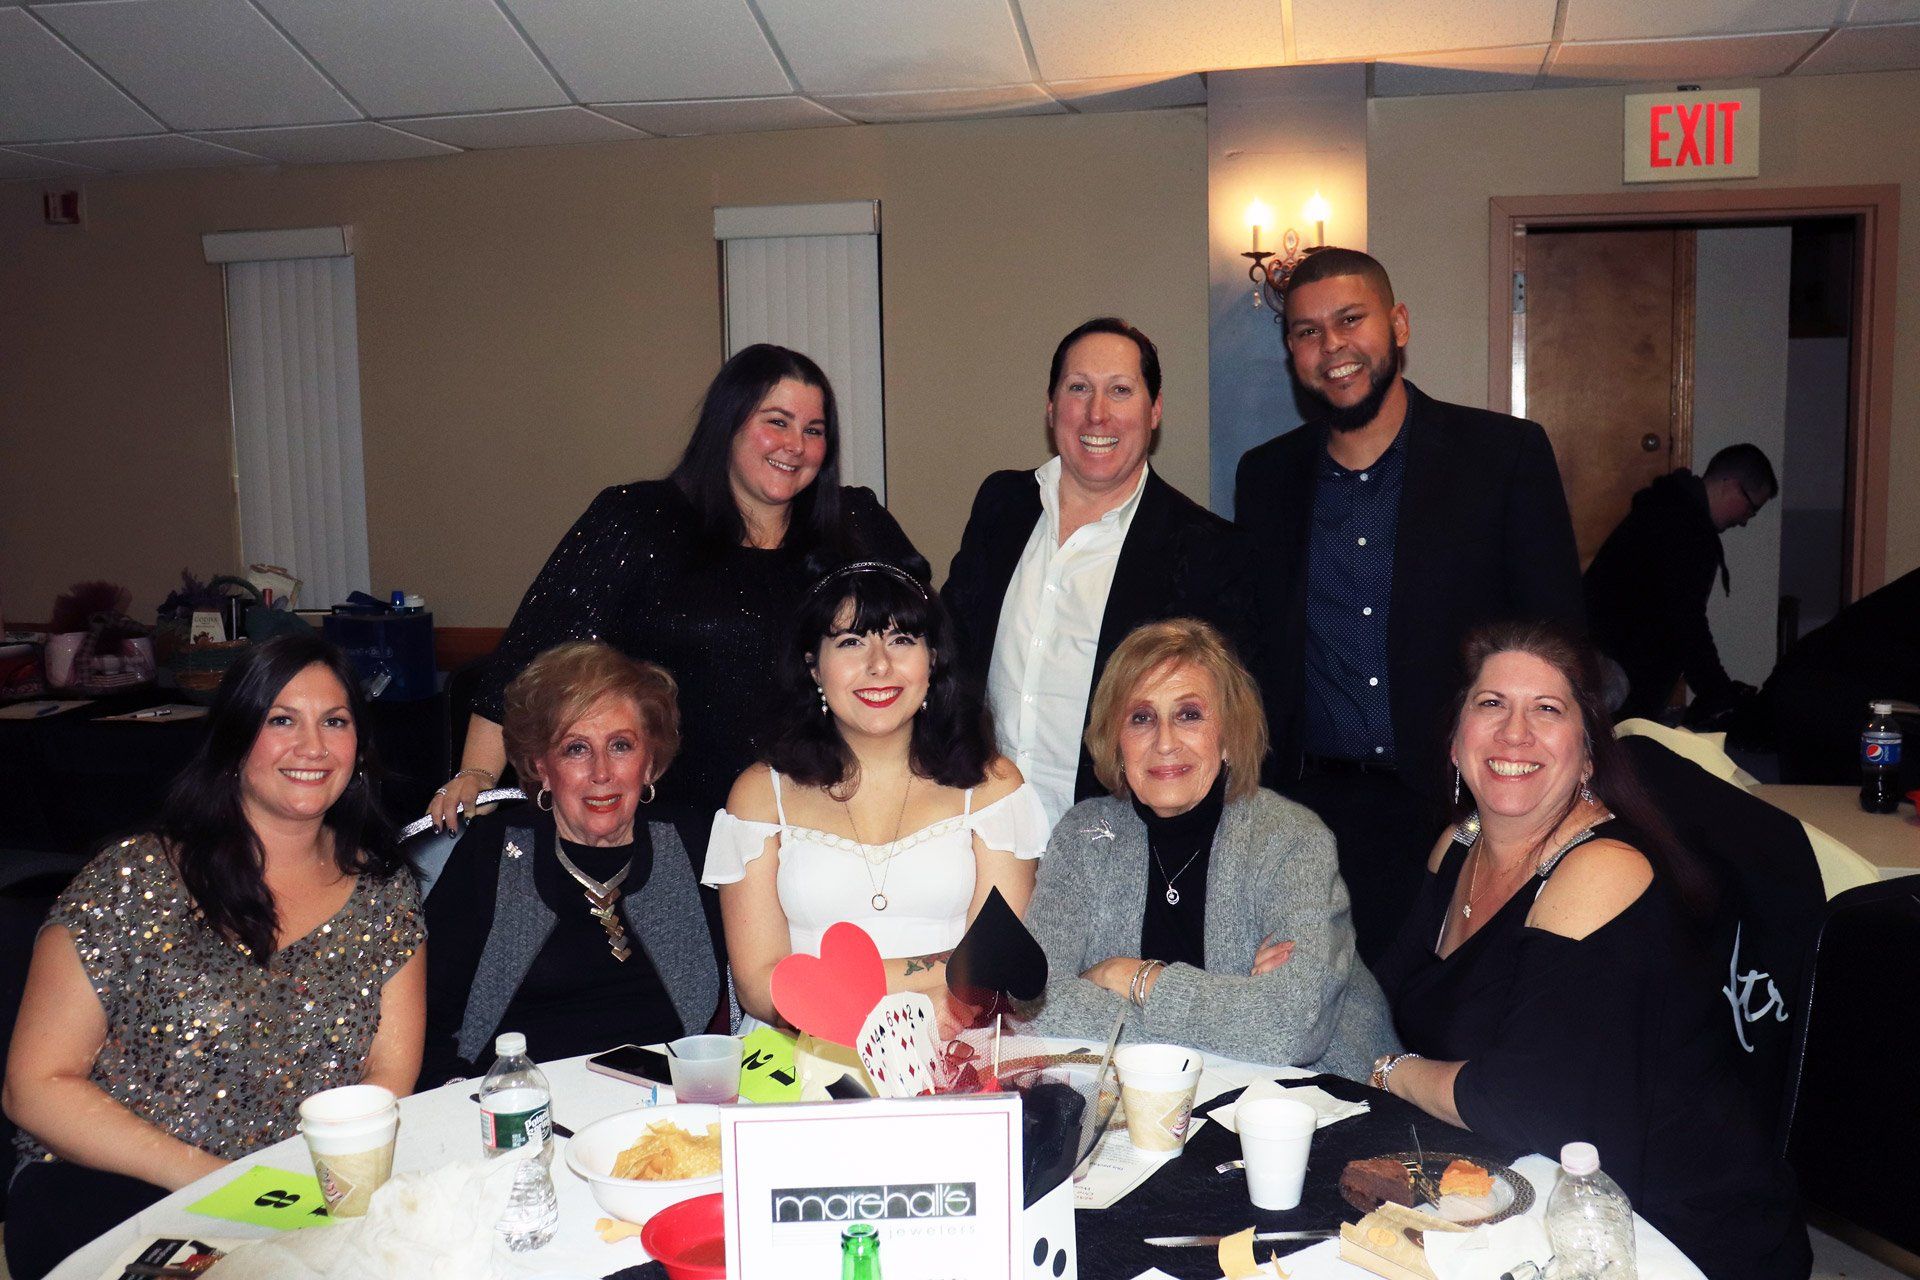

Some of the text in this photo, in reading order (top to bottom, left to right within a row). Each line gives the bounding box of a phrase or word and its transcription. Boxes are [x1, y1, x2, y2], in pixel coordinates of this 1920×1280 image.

[1650, 102, 1742, 168] EXIT
[885, 1011, 894, 1028] 6
[254, 1189, 301, 1209] 8
[775, 1183, 971, 1222] marshall's
[889, 1224, 976, 1240] jewelers
